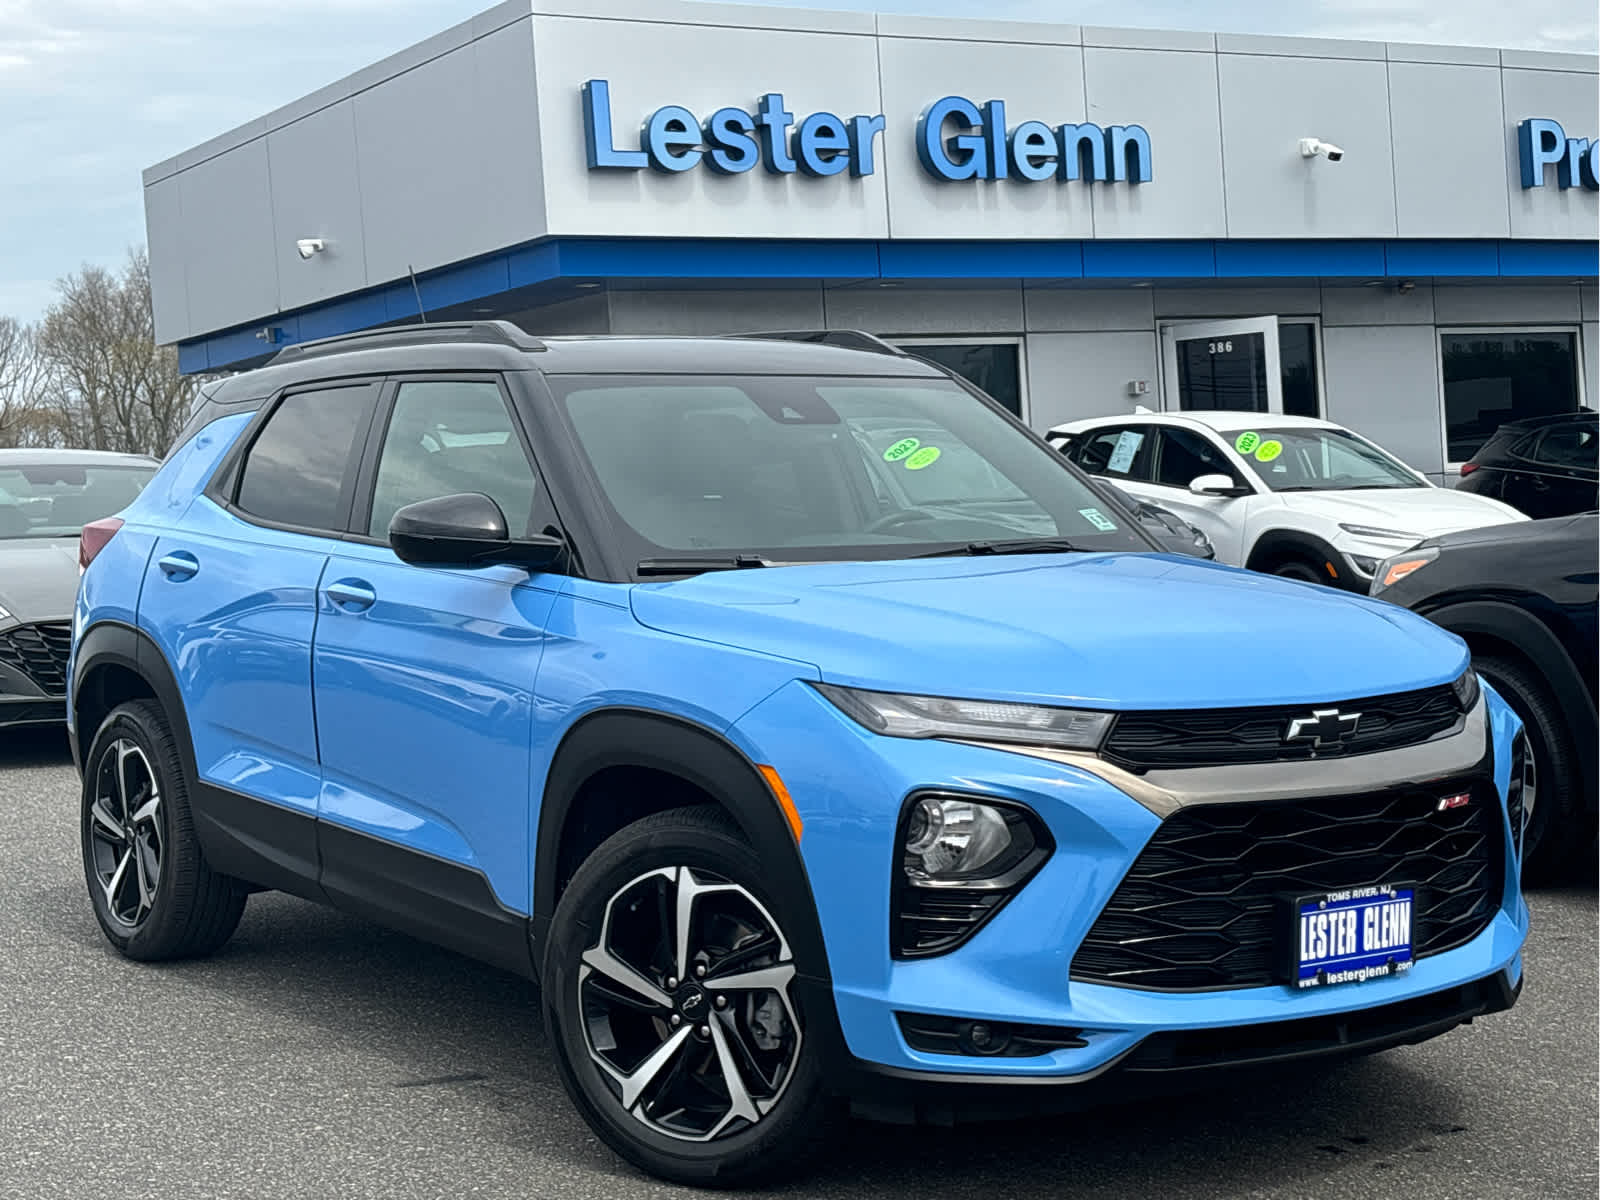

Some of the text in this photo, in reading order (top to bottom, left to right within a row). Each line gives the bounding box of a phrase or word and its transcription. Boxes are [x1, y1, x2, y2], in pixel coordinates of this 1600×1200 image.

[580, 79, 1153, 184] Lester Glenn
[1208, 341, 1233, 354] 386
[887, 439, 917, 459] 2023
[1239, 433, 1257, 451] 2023
[1327, 891, 1351, 903] TOMS
[1380, 884, 1392, 895] NJ
[1300, 901, 1411, 962] LESTER GLENN
[1327, 964, 1389, 985] lesterglenn
